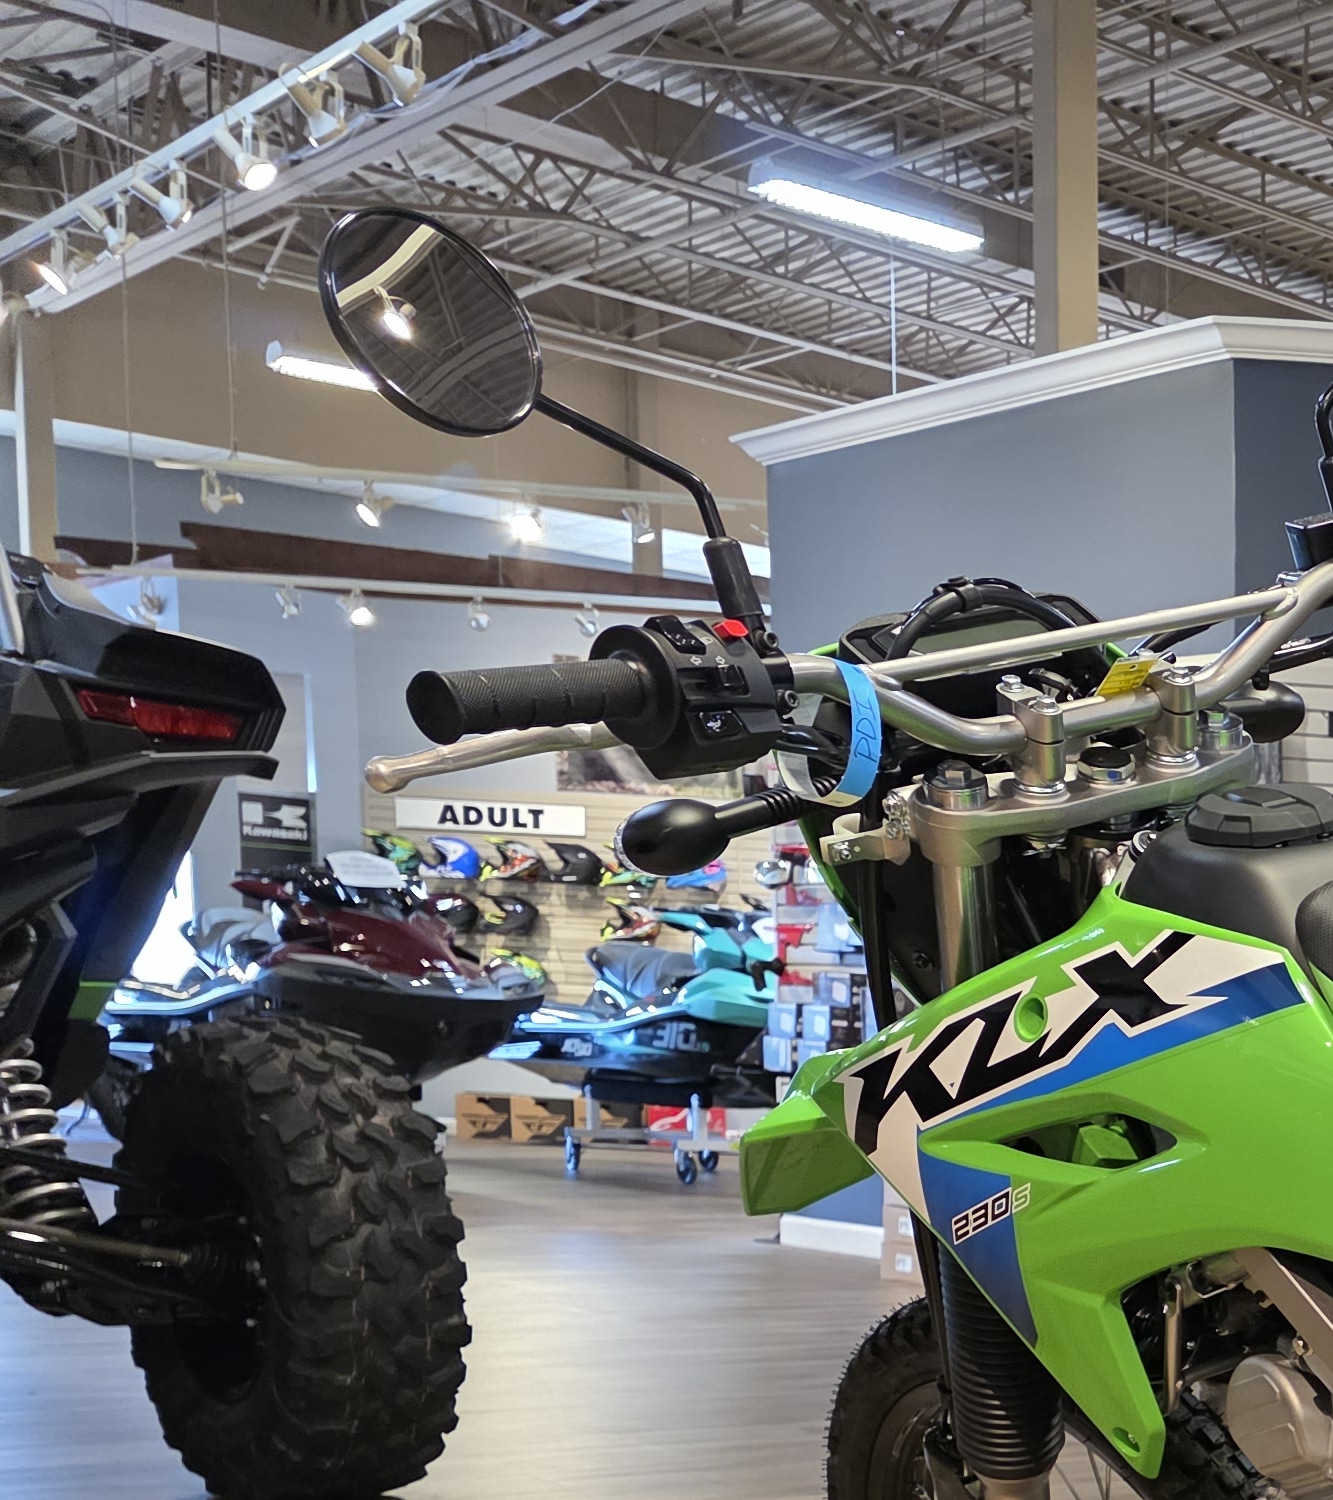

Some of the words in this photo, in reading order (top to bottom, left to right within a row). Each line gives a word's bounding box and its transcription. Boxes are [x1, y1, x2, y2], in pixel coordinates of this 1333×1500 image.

[852, 690, 878, 763] PDI
[437, 804, 545, 829] ADULT
[848, 929, 1198, 1157] KLX
[951, 1182, 1031, 1246] 230S
